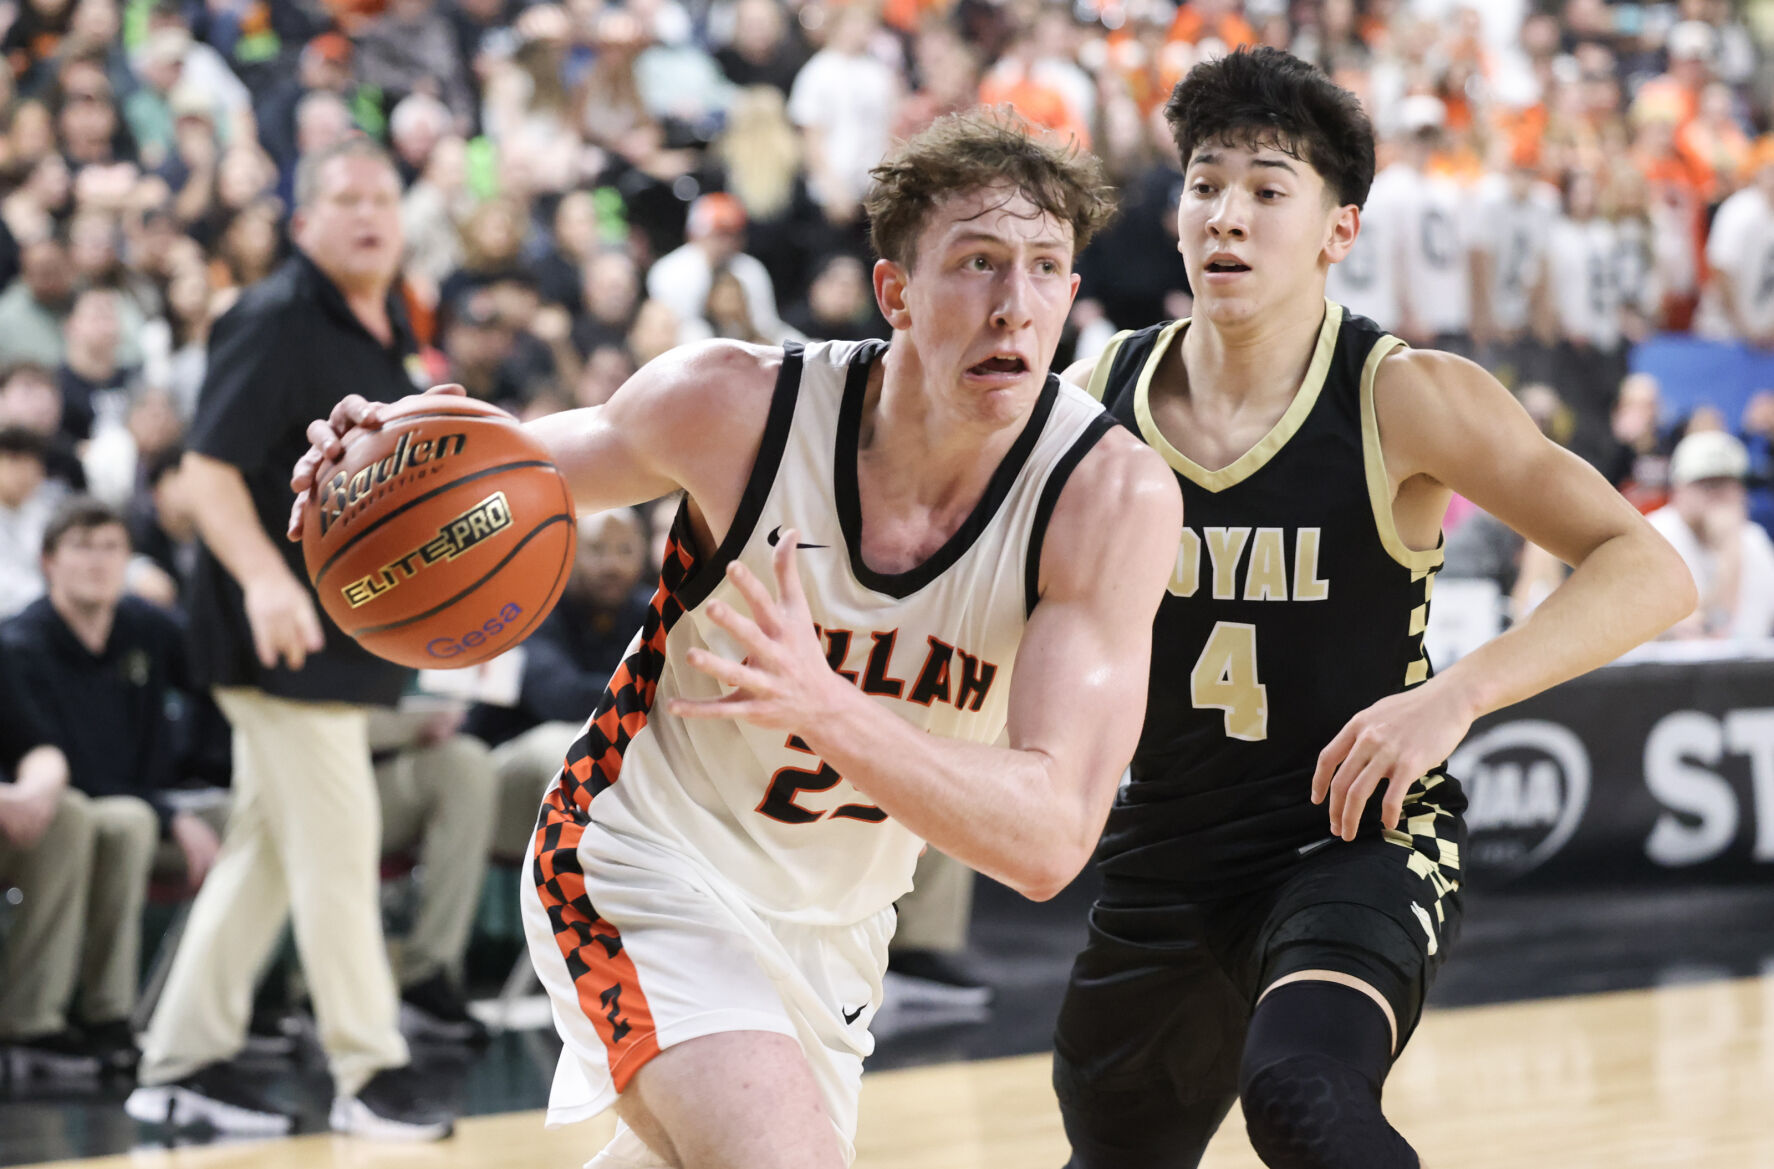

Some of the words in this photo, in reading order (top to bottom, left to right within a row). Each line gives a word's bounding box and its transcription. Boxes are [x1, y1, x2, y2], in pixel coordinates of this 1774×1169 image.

[321, 430, 466, 537] Baden
[341, 528, 457, 609] ELITE
[445, 491, 512, 558] PRO
[1166, 526, 1330, 601] OYAL
[426, 602, 523, 659] Gesa
[1190, 620, 1268, 742] 4
[754, 733, 889, 825] 2
